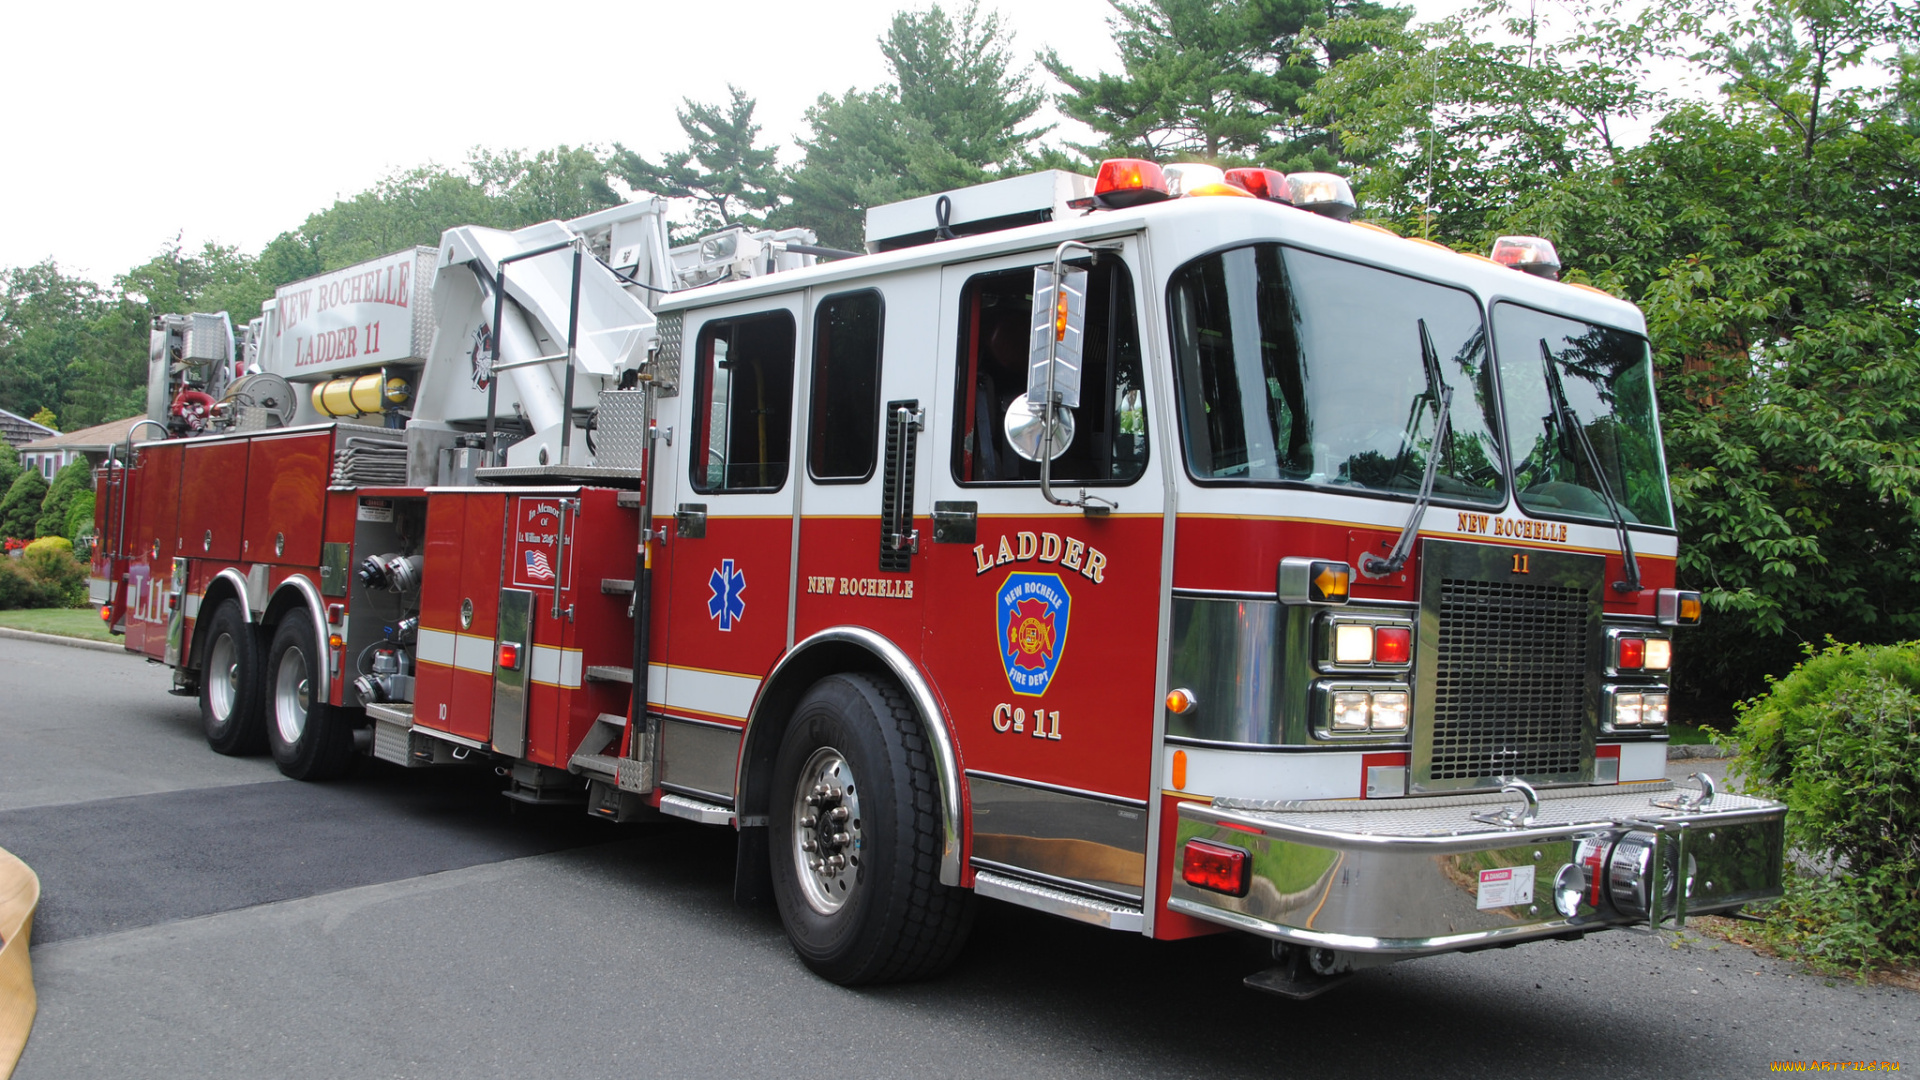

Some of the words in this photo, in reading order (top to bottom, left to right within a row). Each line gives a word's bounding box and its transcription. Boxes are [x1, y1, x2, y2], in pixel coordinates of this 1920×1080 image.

[277, 288, 313, 337] NEW
[317, 261, 410, 313] ROCHELLE
[295, 326, 358, 367] LADDER
[364, 320, 380, 355] 11
[1457, 512, 1490, 534] NEW
[1494, 517, 1568, 543] ROCHELLE
[973, 531, 1107, 584] LADDER
[1511, 553, 1530, 574] 11
[133, 575, 164, 625] L11
[807, 576, 836, 594] NEW
[839, 577, 914, 599] ROCHELLE
[1004, 584, 1022, 606] NEW
[1024, 581, 1063, 610] ROCHELLE
[1009, 667, 1026, 685] FIRE
[1028, 670, 1049, 686] DEPT
[438, 703, 447, 720] 10
[1032, 708, 1062, 740] 11
